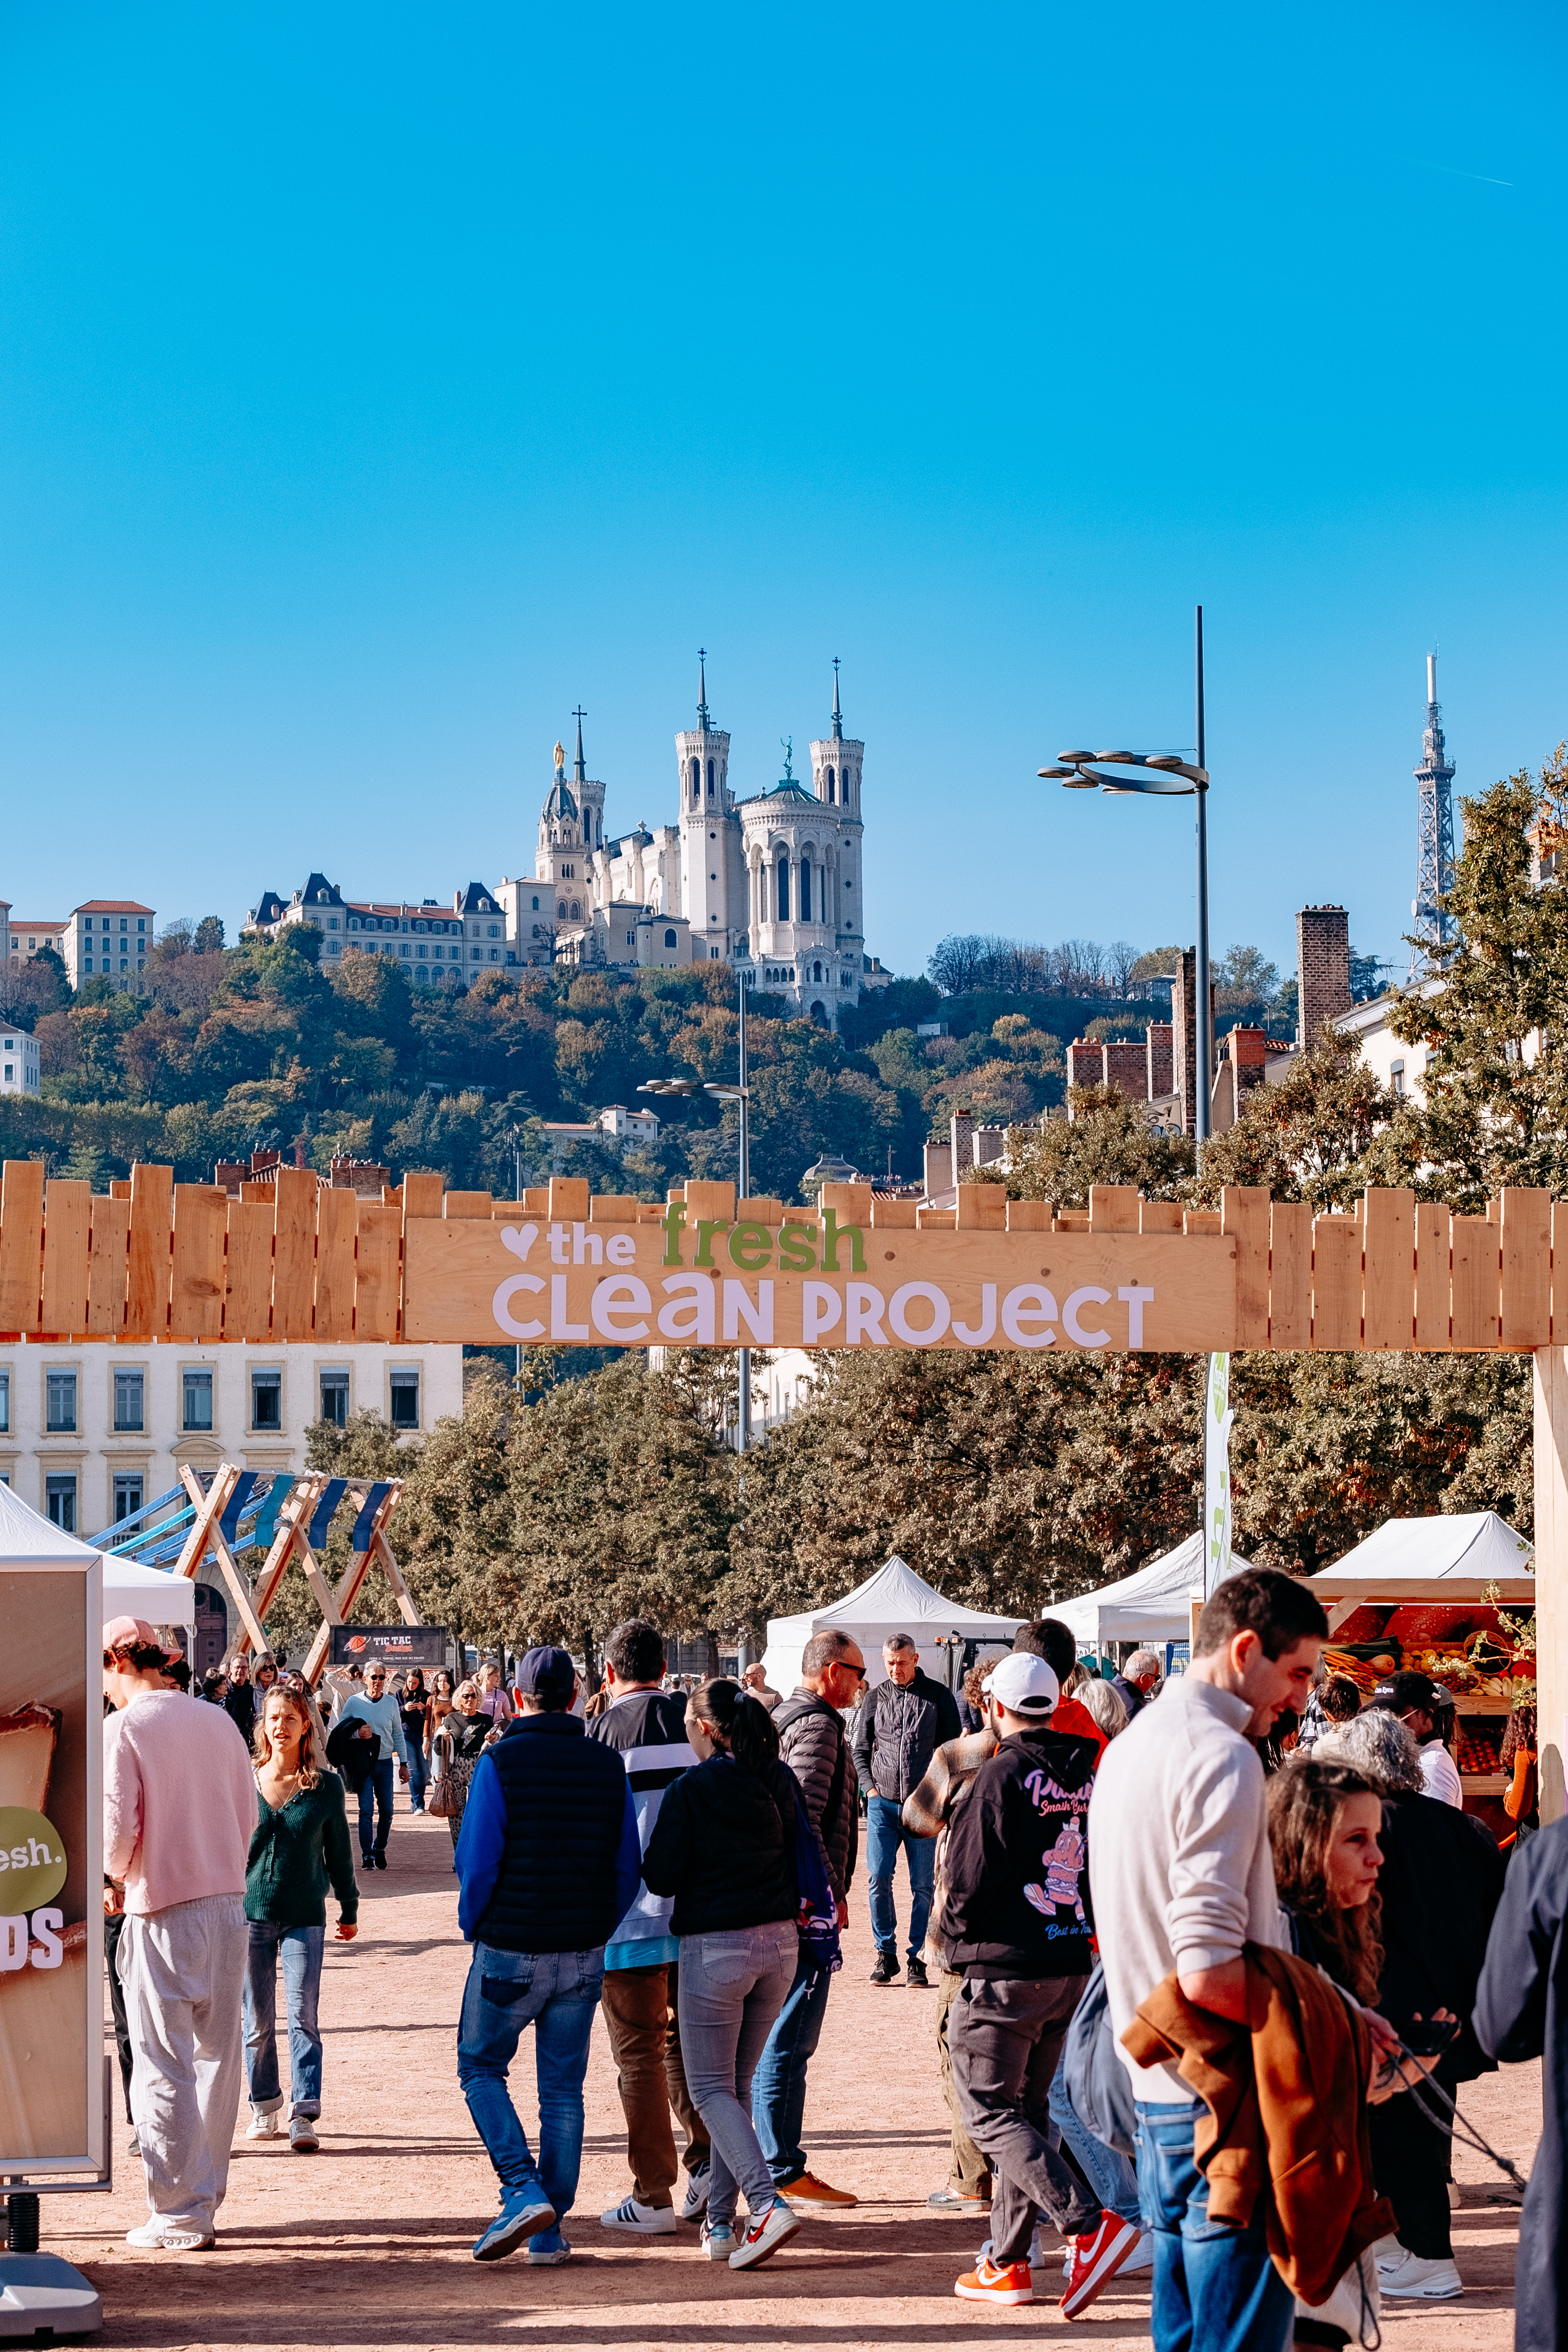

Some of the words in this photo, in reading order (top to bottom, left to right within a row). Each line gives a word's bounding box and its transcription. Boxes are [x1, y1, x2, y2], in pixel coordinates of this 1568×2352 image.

[547, 1223, 635, 1265] the
[661, 1201, 867, 1273] fresh
[373, 1637, 390, 1646] TIC
[391, 1636, 411, 1645] TAC
[1038, 1799, 1071, 1817] Smash
[1045, 1924, 1068, 1940] Best
[1070, 1924, 1079, 1935] in
